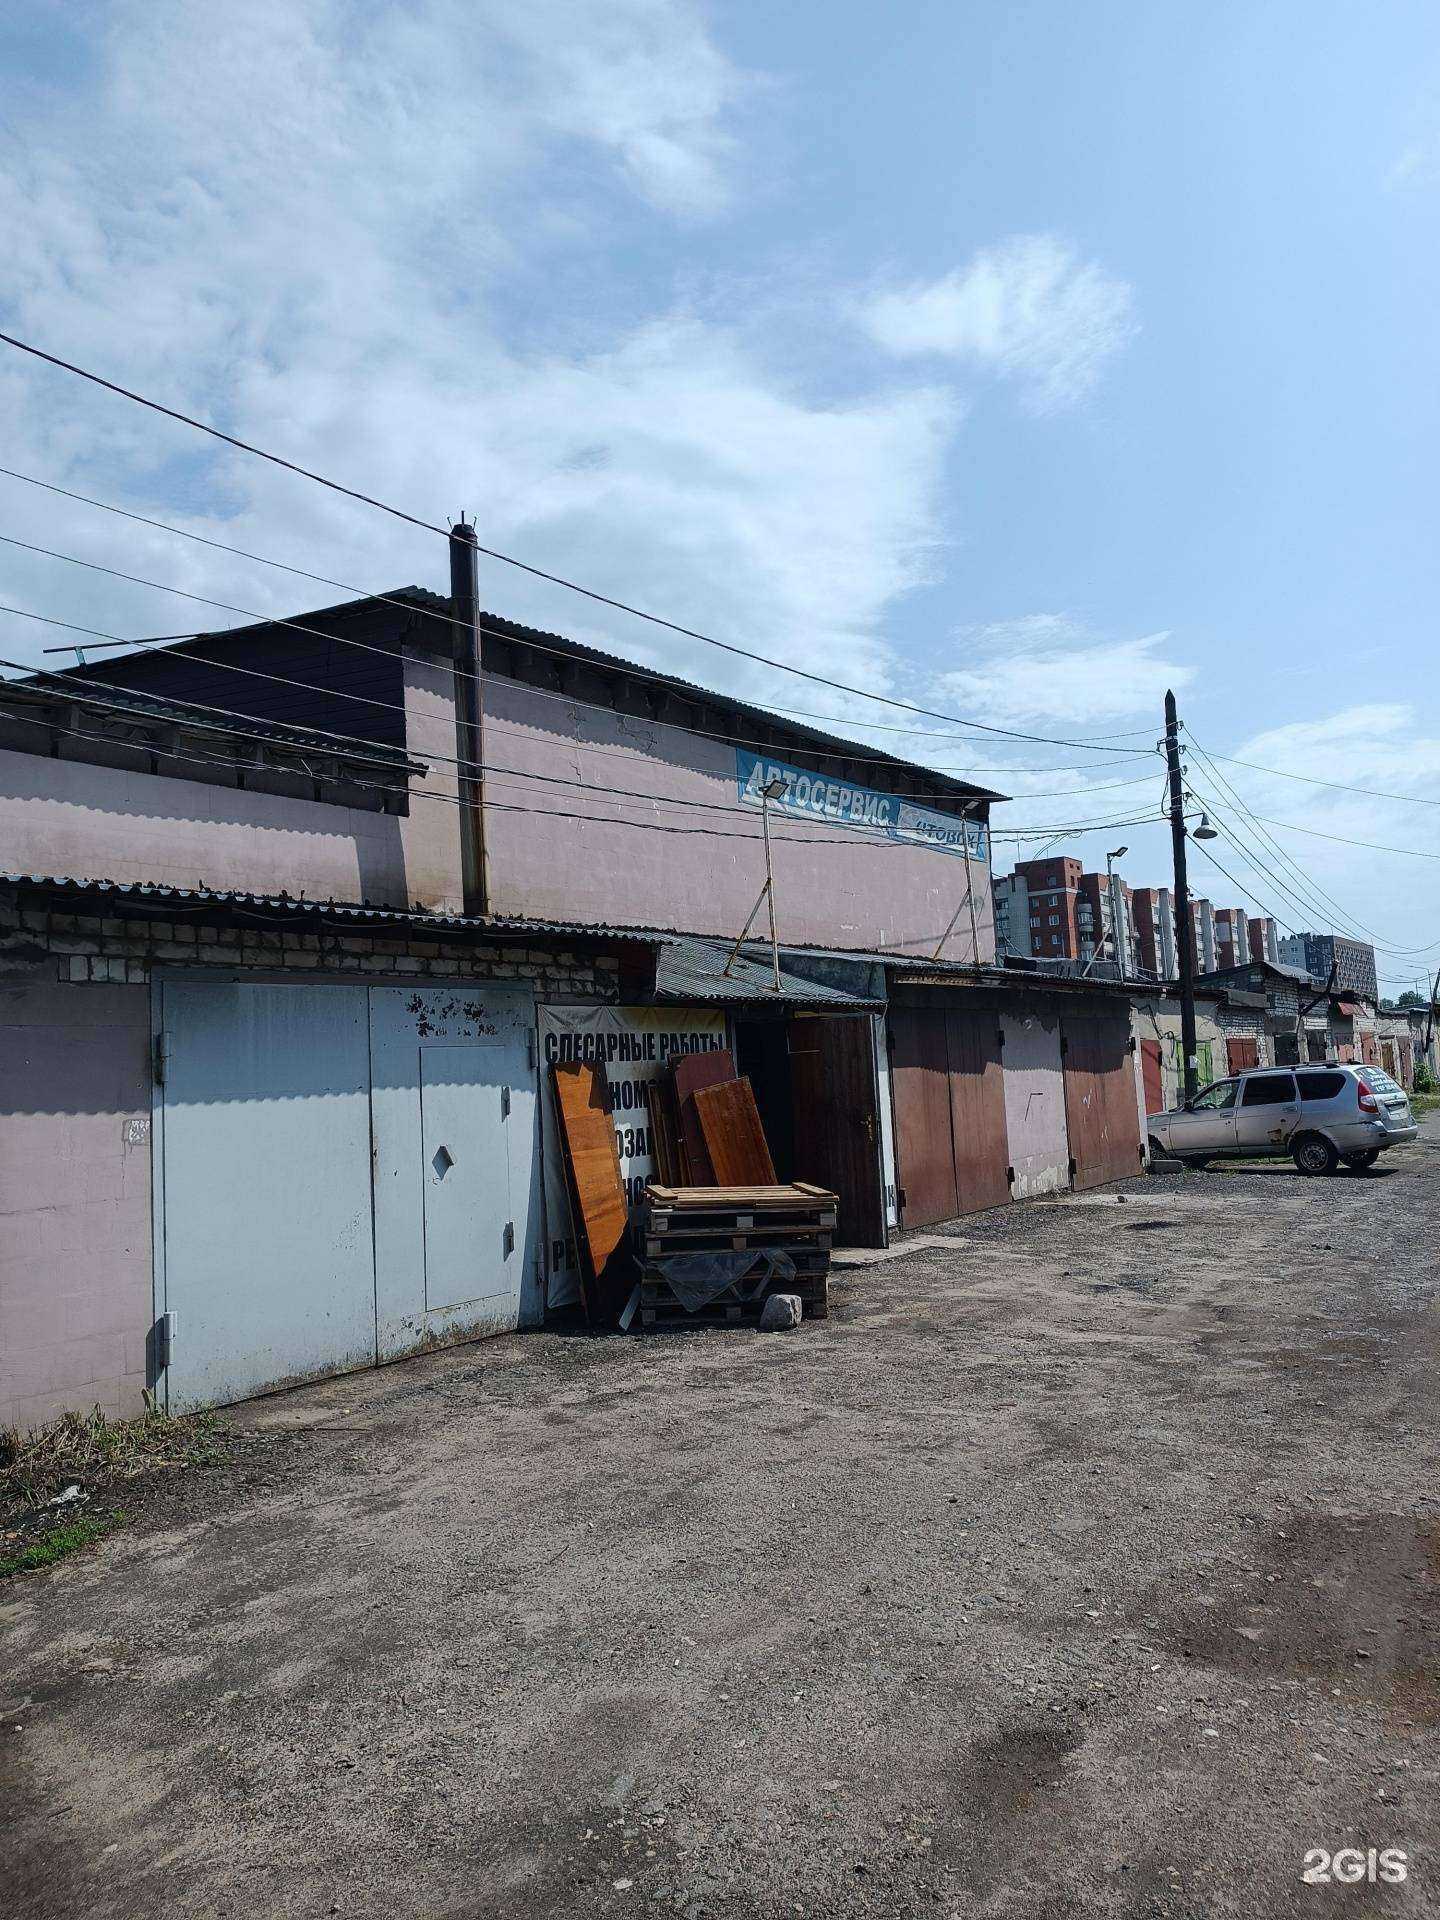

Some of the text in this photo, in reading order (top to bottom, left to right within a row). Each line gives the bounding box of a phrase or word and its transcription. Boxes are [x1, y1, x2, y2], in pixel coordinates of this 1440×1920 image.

[745, 760, 892, 825] АВТОСЕРВИС
[544, 1031, 723, 1064] СЛЕСАРНЫЕ РАБОТЫ
